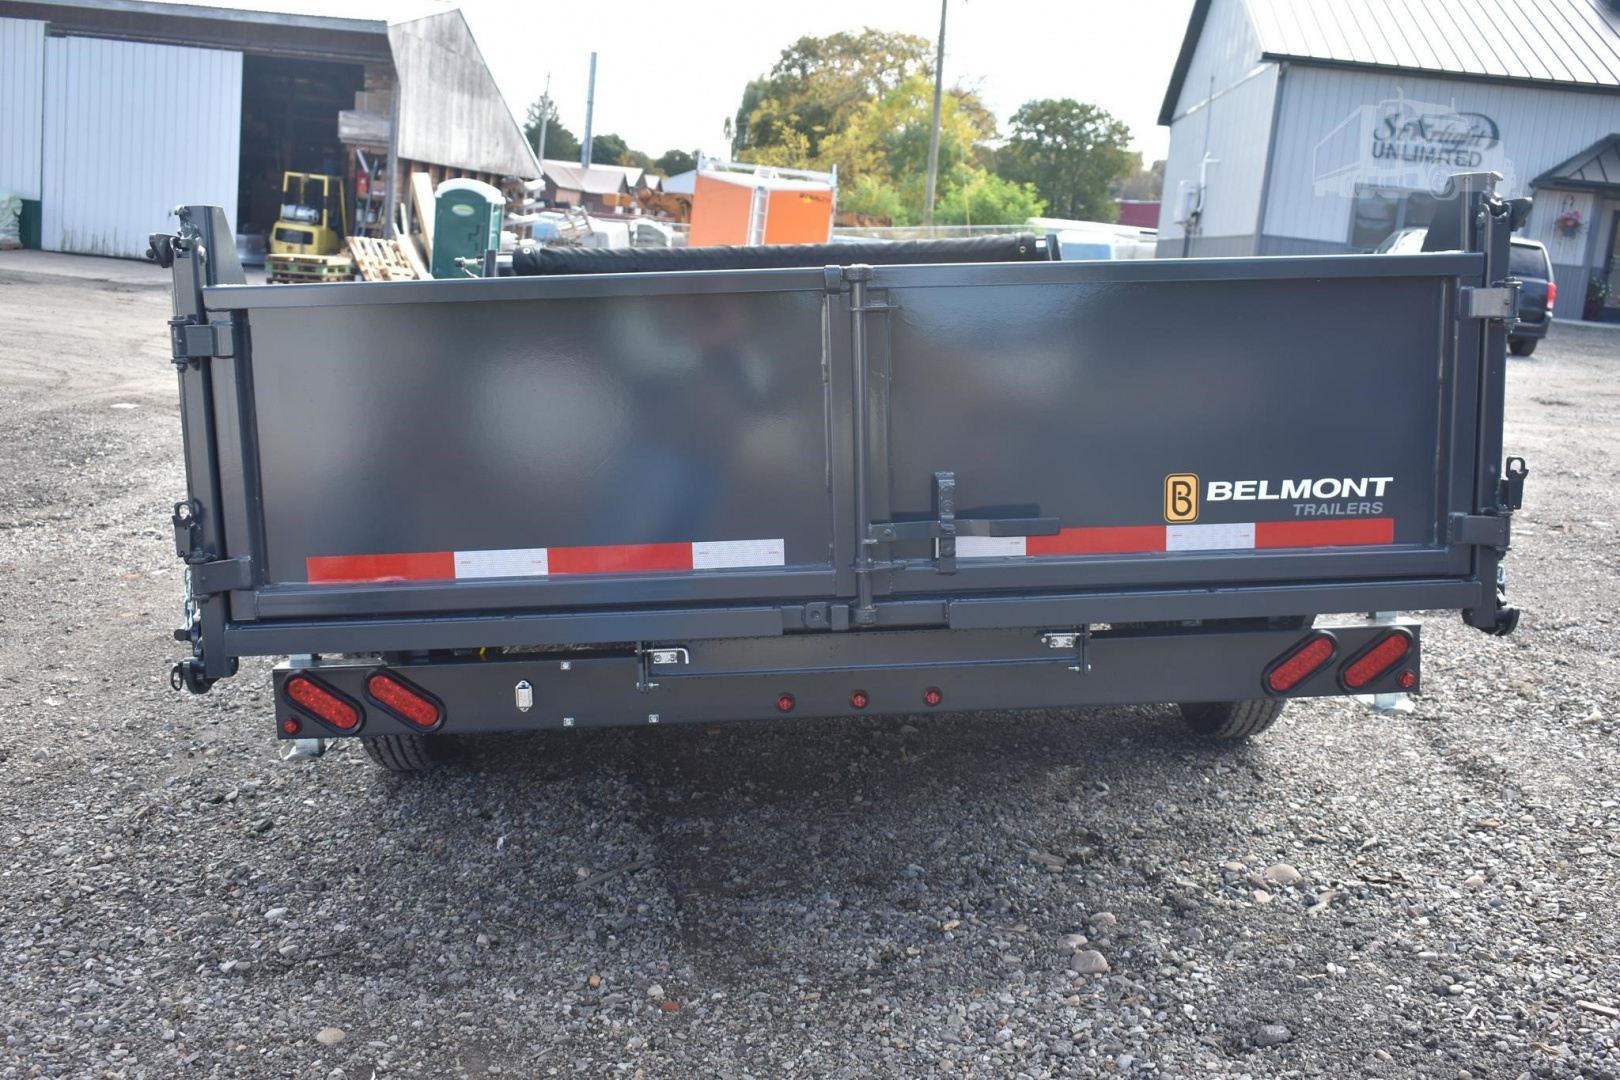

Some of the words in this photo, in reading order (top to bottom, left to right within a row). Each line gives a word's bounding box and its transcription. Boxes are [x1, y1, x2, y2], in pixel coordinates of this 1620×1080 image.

[1372, 140, 1482, 167] UNLIMITED
[1206, 477, 1394, 501] BELMONT
[1293, 502, 1383, 516] TRAILERS
